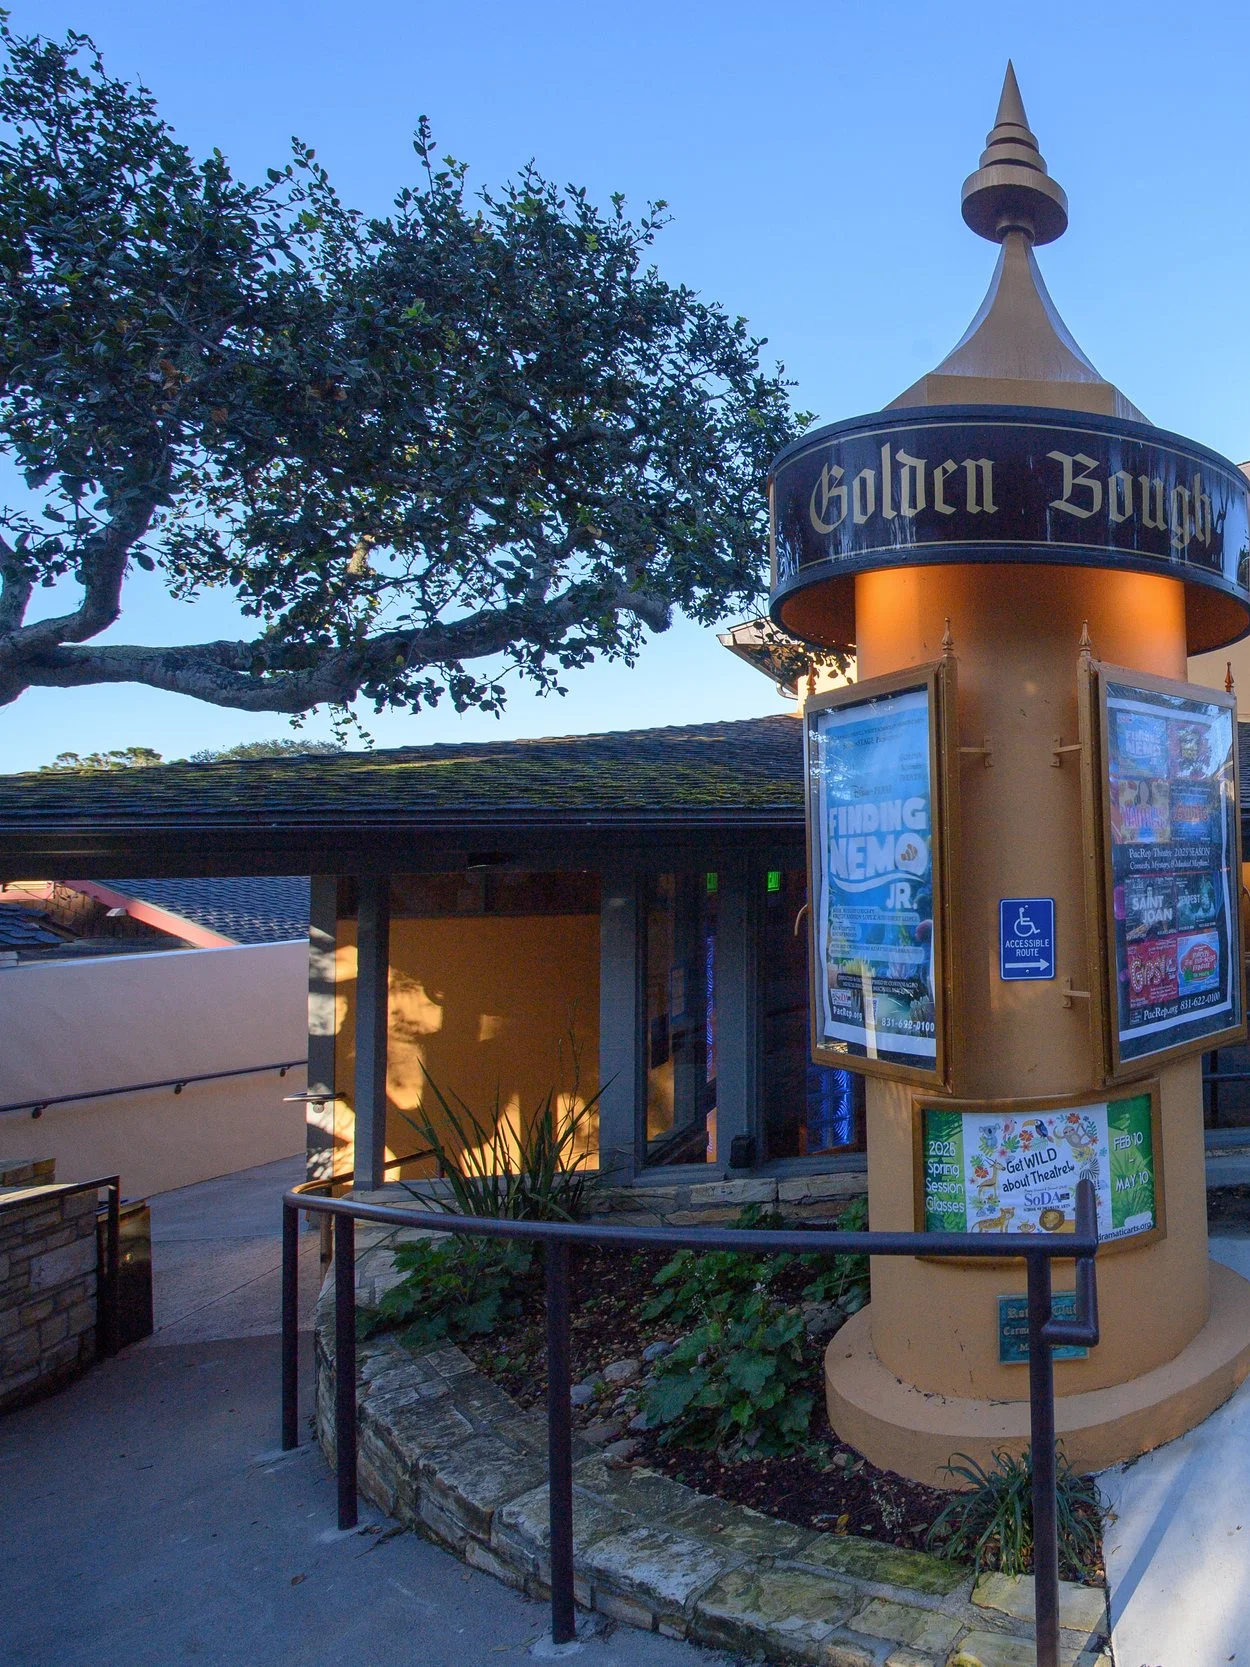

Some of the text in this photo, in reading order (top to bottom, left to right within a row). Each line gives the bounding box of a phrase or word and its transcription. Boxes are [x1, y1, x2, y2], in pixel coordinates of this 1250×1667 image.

[810, 443, 1212, 548] Golden Bough
[829, 797, 926, 836] FINDING
[830, 832, 928, 880] NEMO
[885, 882, 918, 909] JR.
[1132, 895, 1164, 911] SAINT
[1142, 908, 1173, 923] JOAN
[1005, 939, 1050, 948] ACCESSIBLE
[1016, 948, 1039, 957] ROUTE
[833, 1006, 862, 1021] PacRep.org
[929, 1141, 955, 1156] 2025
[1113, 1131, 1144, 1151] FEB 10
[928, 1160, 959, 1178] Spring
[1006, 1148, 1057, 1174] Get WILD
[1003, 1160, 1073, 1192] about Theatre!
[1116, 1171, 1149, 1192] MAY 10
[926, 1178, 963, 1194] Session
[926, 1196, 964, 1213] Classes
[1024, 1191, 1061, 1207] SoDA
[1098, 1221, 1152, 1240] dramaticarts.org
